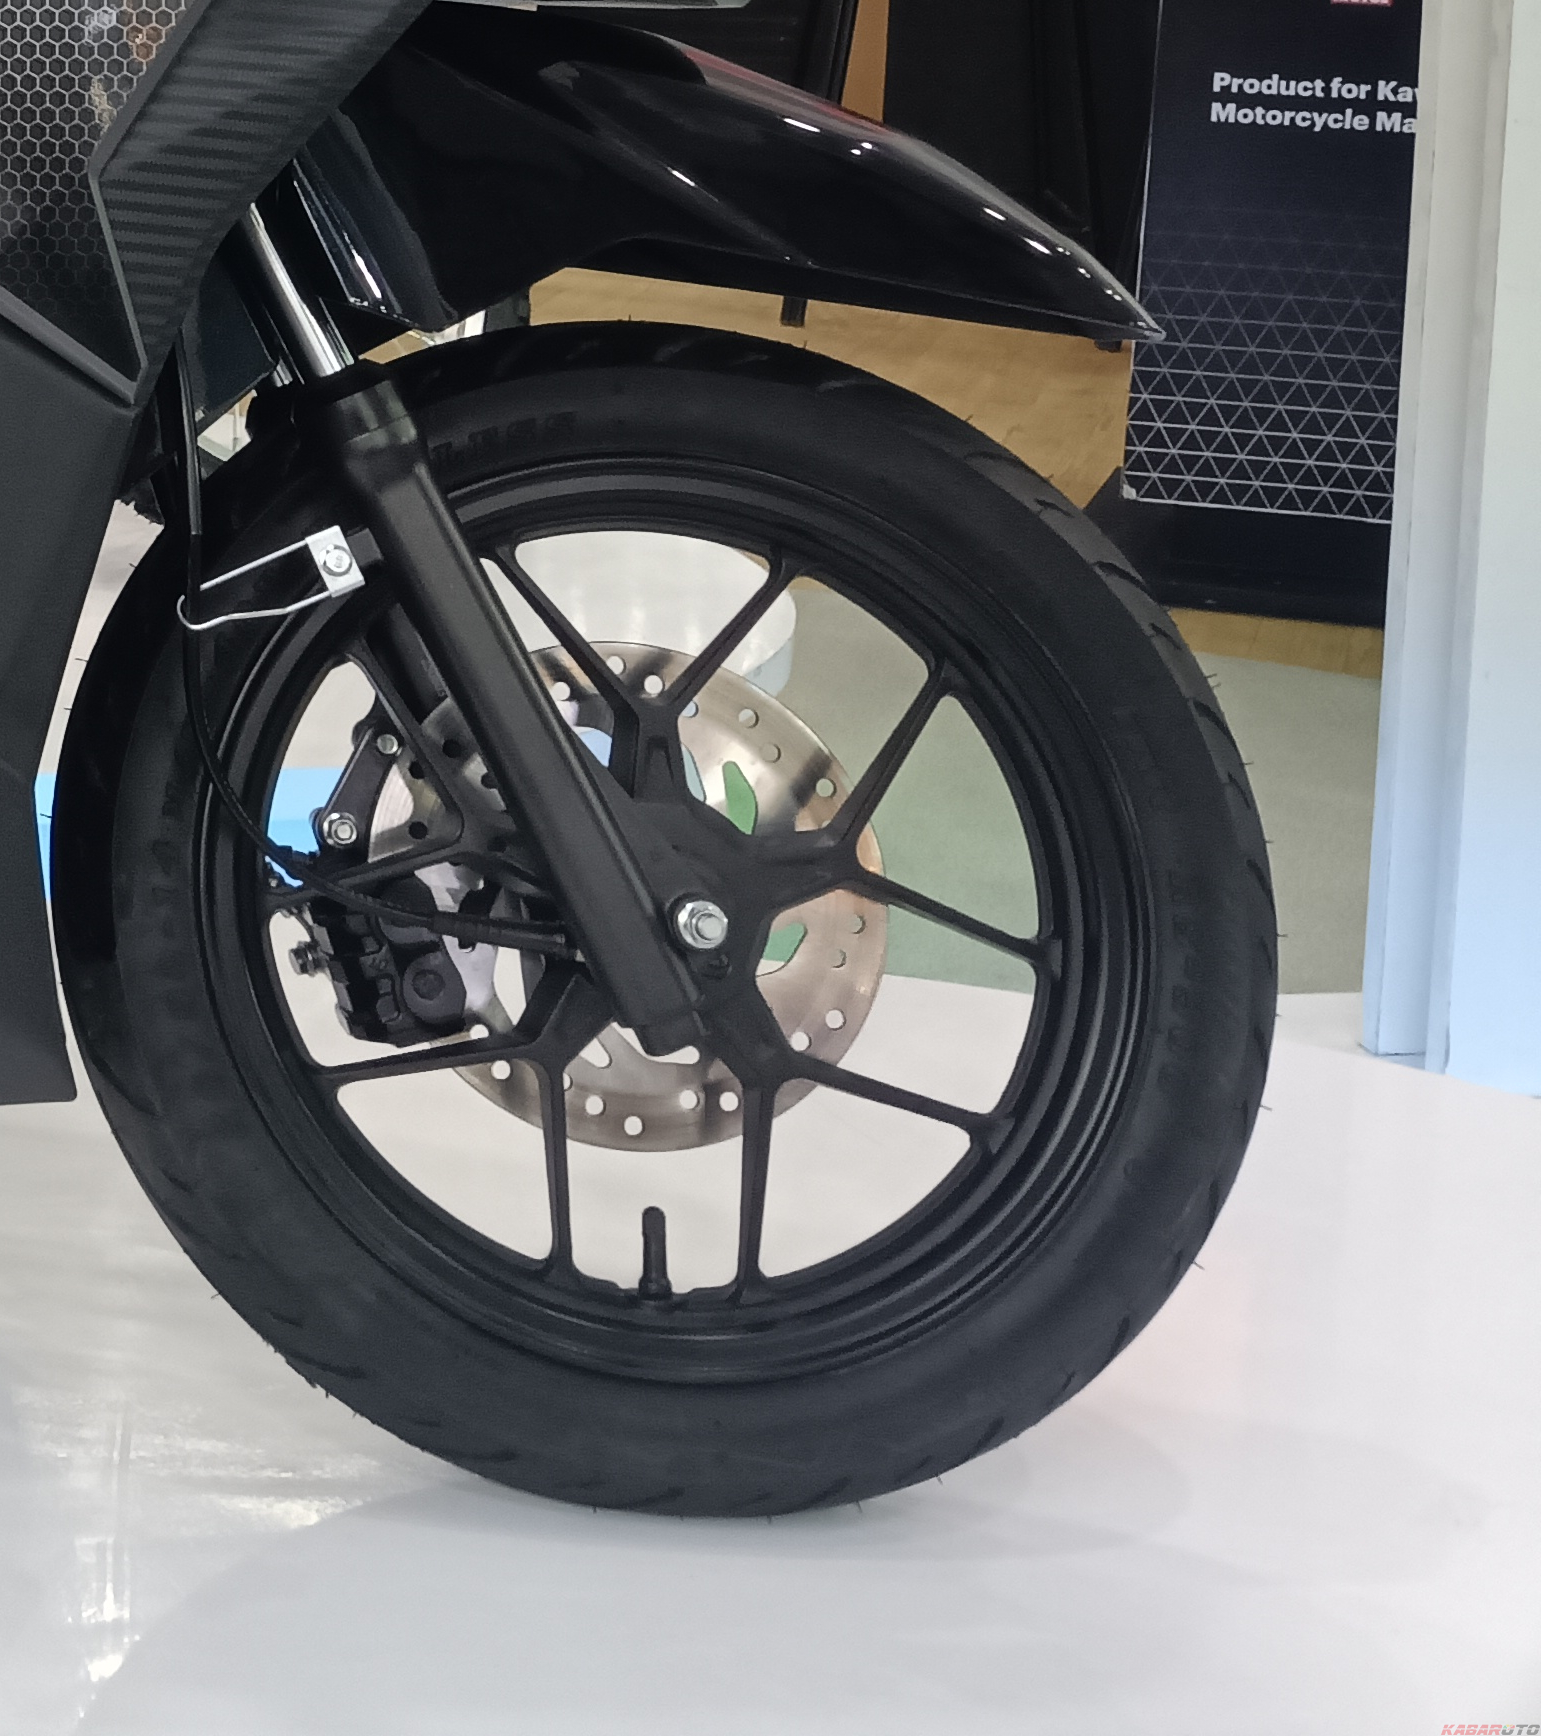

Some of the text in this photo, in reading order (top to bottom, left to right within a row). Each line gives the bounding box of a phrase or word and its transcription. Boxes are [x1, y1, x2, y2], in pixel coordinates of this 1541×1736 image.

[1212, 71, 1326, 98] Product
[1330, 76, 1372, 100] for
[1210, 101, 1370, 132] Motorcycle
